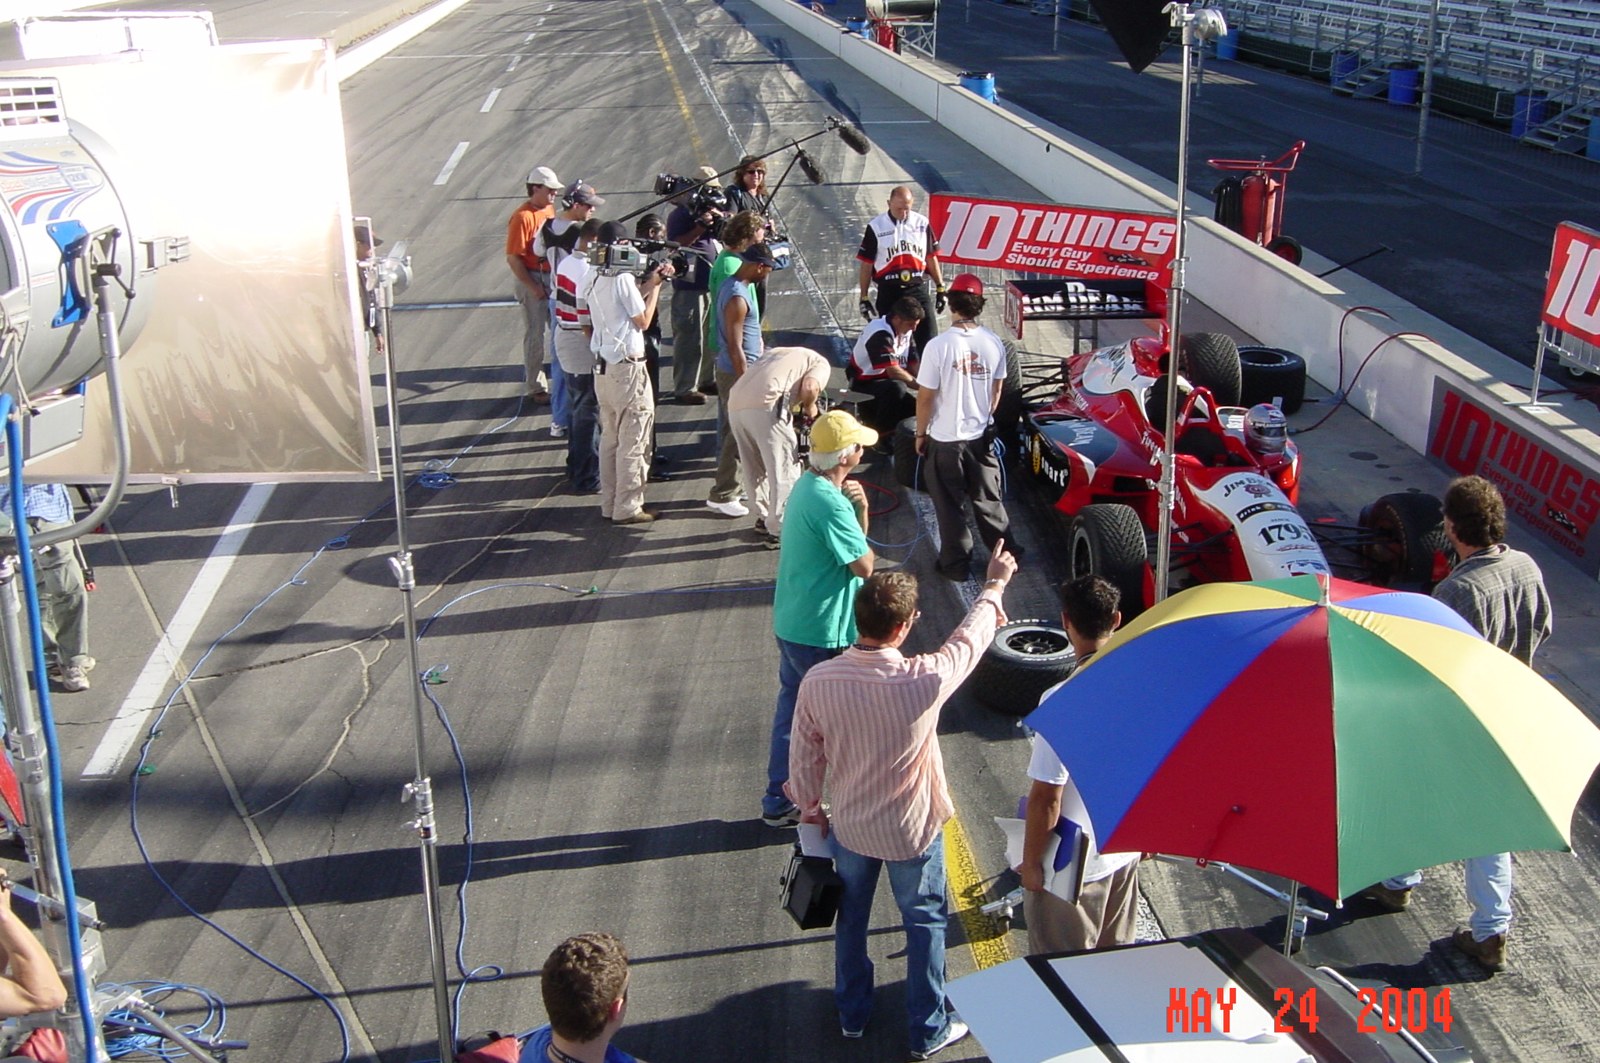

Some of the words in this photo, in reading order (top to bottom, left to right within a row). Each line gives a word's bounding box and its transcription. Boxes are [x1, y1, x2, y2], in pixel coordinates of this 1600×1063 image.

[938, 201, 1018, 261] 10
[1011, 242, 1060, 257] Every
[1060, 246, 1092, 261] Guy
[1005, 253, 1063, 269] Should
[1064, 260, 1160, 281] Experience
[1431, 389, 1492, 477] 10
[1223, 478, 1246, 498] JIM
[1481, 461, 1514, 491] Every
[1514, 478, 1537, 507] Guy
[1515, 503, 1586, 558] Experience
